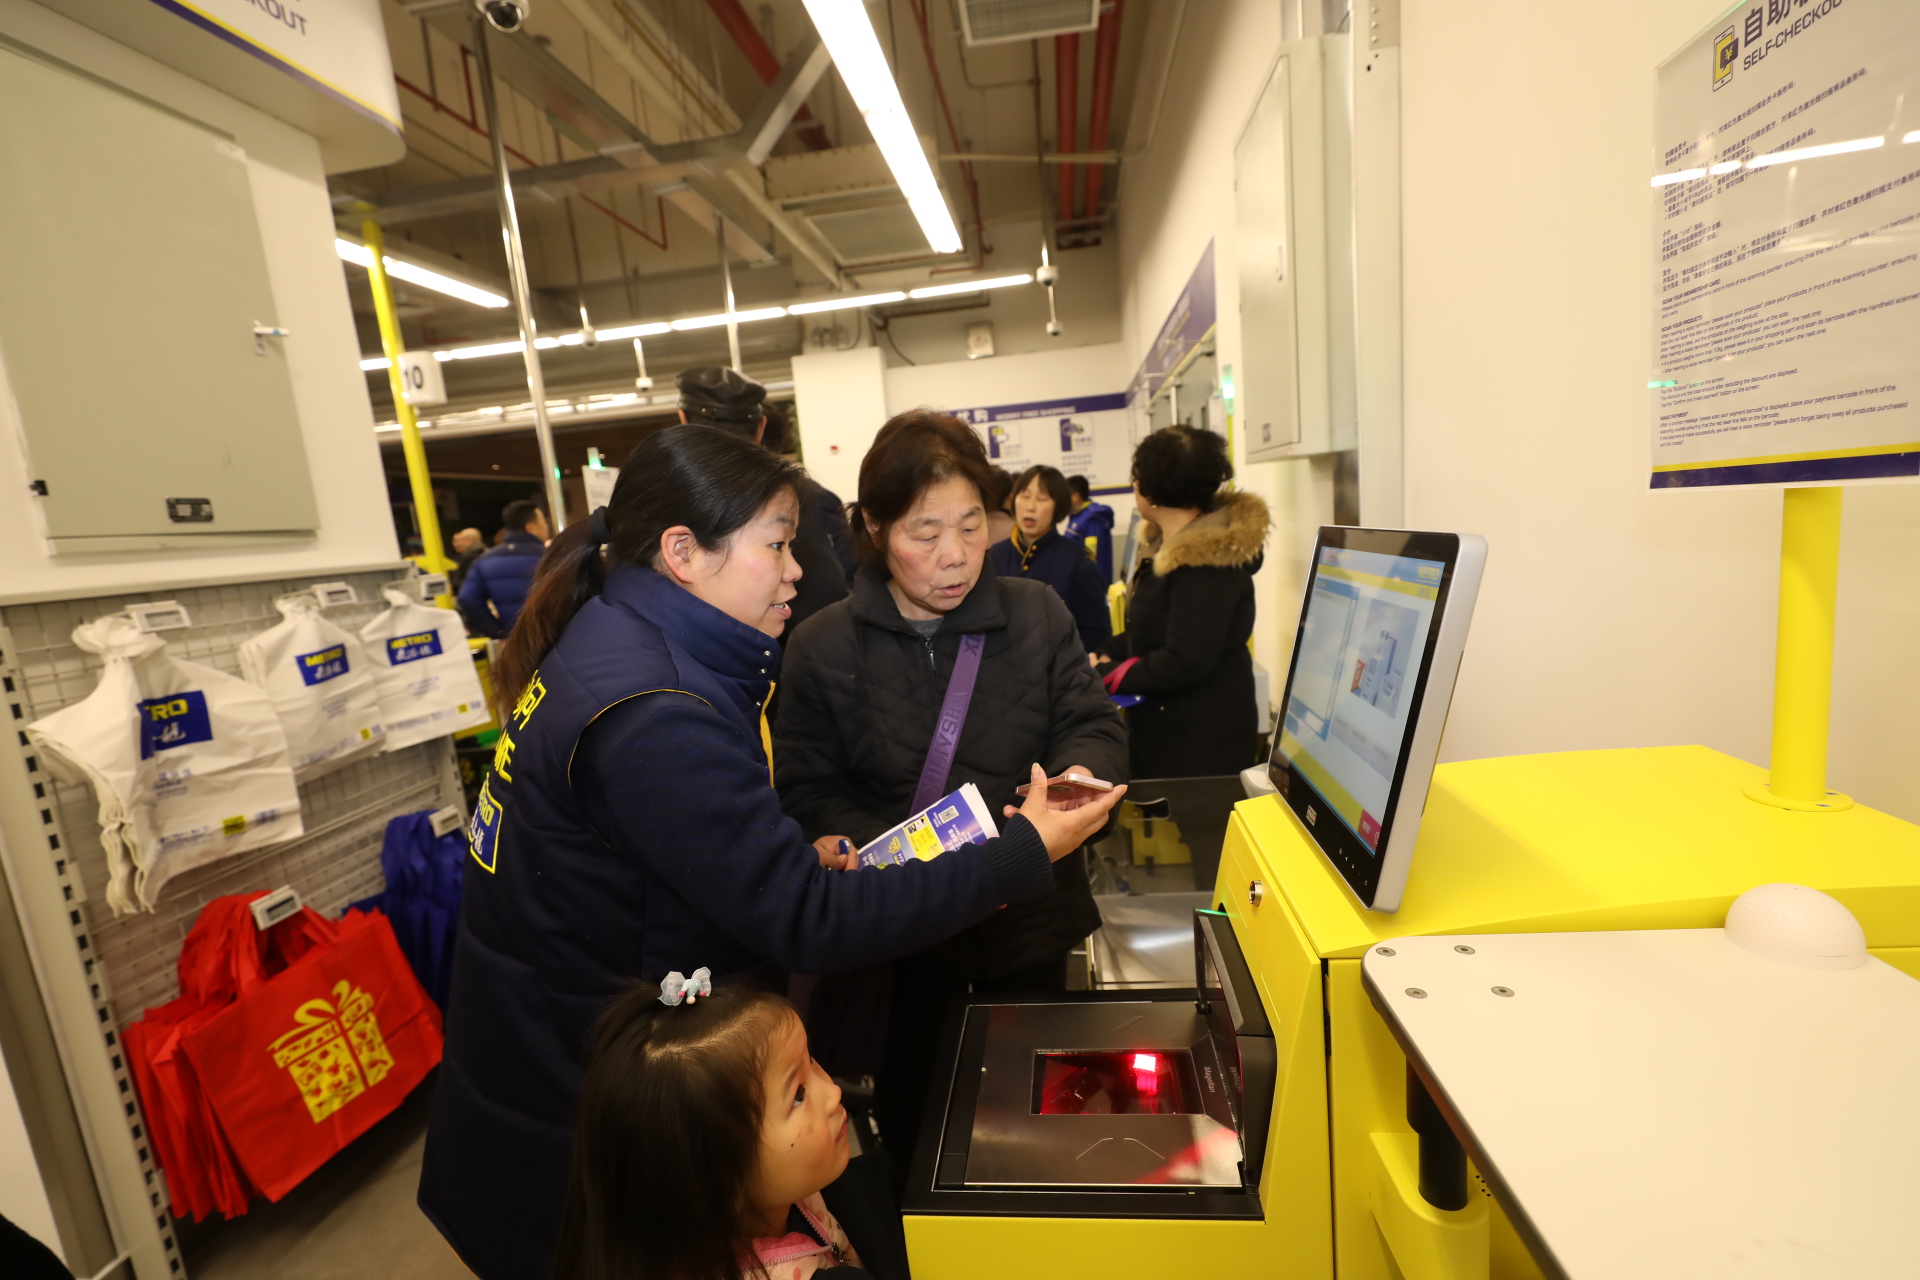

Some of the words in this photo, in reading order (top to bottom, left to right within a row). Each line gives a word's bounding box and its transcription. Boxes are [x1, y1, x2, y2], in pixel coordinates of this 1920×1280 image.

[1744, 0, 1808, 48] 自助
[404, 365, 424, 391] 10
[391, 633, 433, 650] METRO
[305, 648, 342, 667] METRO
[1203, 1066, 1216, 1093] Magellan
